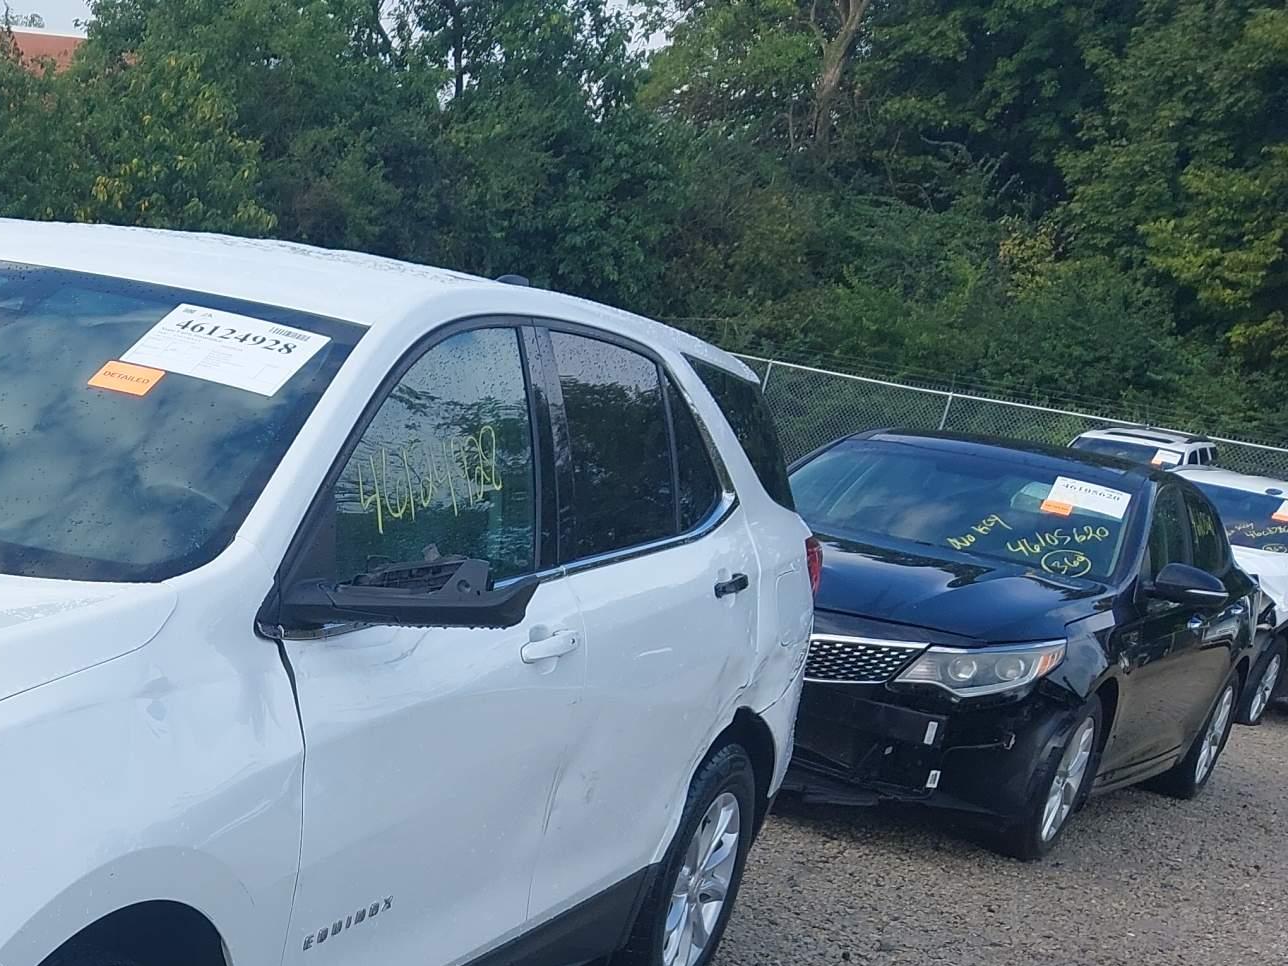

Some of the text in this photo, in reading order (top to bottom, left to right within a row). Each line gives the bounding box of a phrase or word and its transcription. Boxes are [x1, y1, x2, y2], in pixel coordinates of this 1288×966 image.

[175, 318, 298, 355] 46124928
[103, 370, 150, 385] DETAILED
[302, 895, 393, 951] EQUINOX
